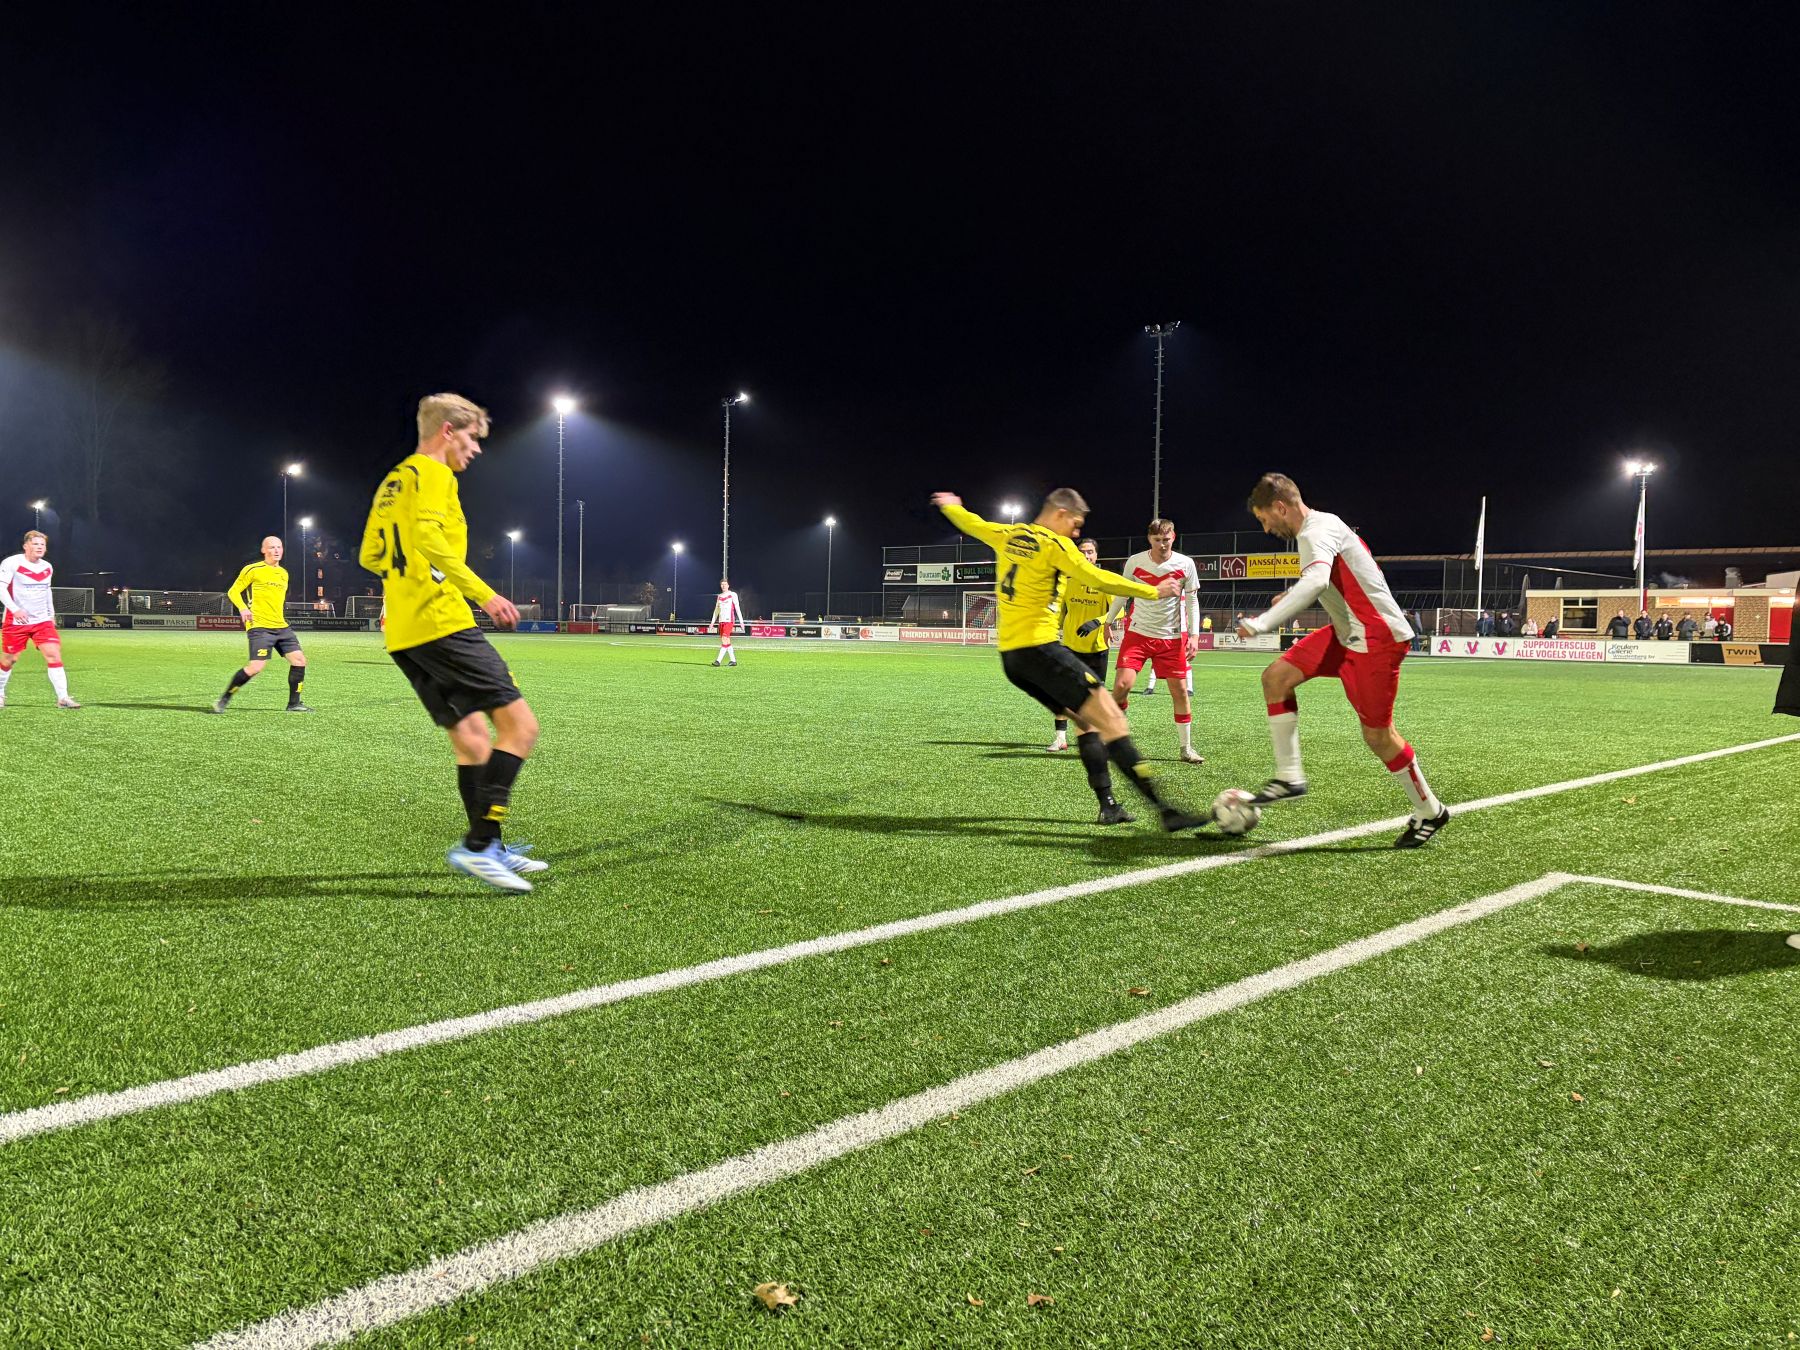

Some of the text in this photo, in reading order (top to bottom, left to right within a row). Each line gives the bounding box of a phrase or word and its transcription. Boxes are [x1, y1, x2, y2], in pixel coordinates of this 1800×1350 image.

[1197, 560, 1217, 572] o.nl
[1249, 559, 1282, 567] JANSSEN
[1001, 564, 1018, 602] 4
[930, 631, 943, 639] VAN
[1439, 640, 1507, 656] A V V
[1523, 641, 1596, 650] SUPPORTERSCLUB
[1515, 650, 1604, 660] ALLE VOGELS VLIEGEN
[1725, 648, 1757, 656] TWIN
